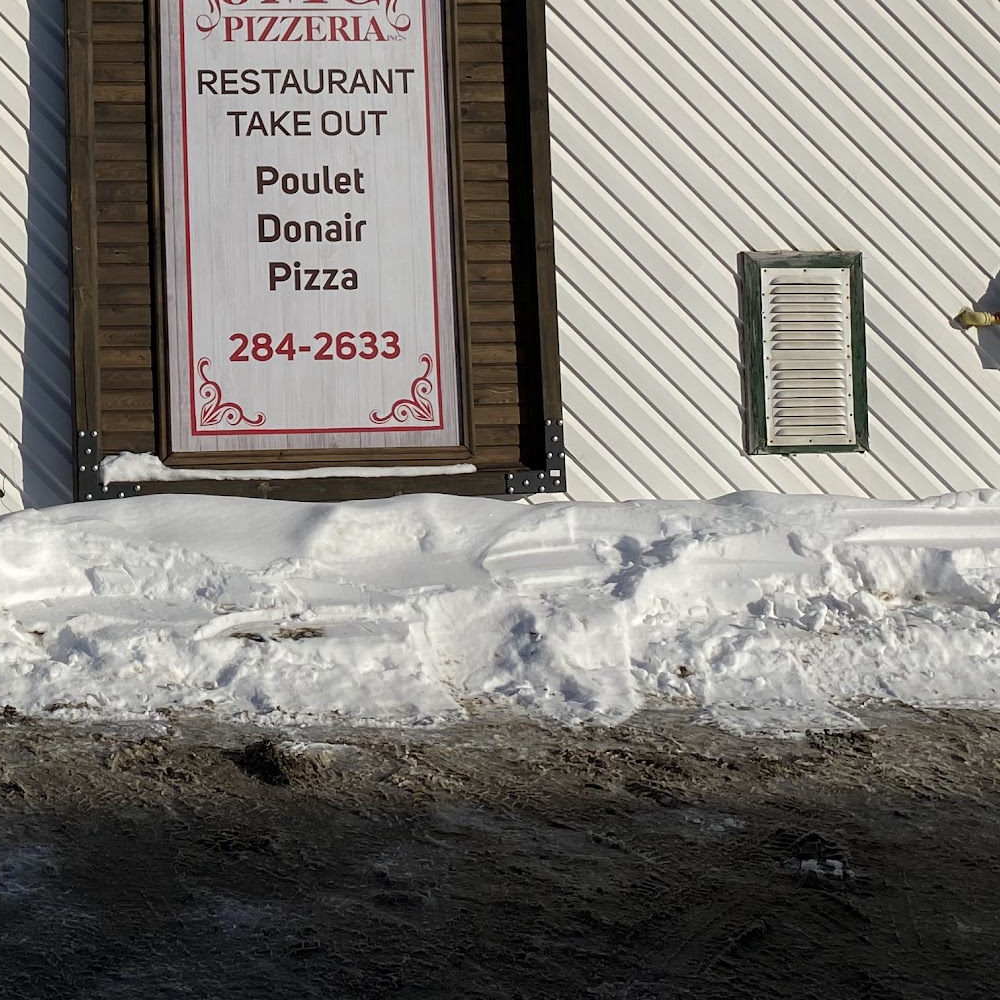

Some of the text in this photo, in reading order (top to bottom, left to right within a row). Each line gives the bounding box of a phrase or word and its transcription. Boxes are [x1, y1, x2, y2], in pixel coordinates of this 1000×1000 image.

[221, 15, 387, 42] PIZZERIA
[197, 68, 415, 95] RESTAURANT
[226, 110, 388, 137] TAKE OUT
[256, 165, 366, 195] Poulet
[257, 212, 367, 243] Donair
[268, 261, 359, 291] Pizza
[228, 330, 401, 362] 284-2633
